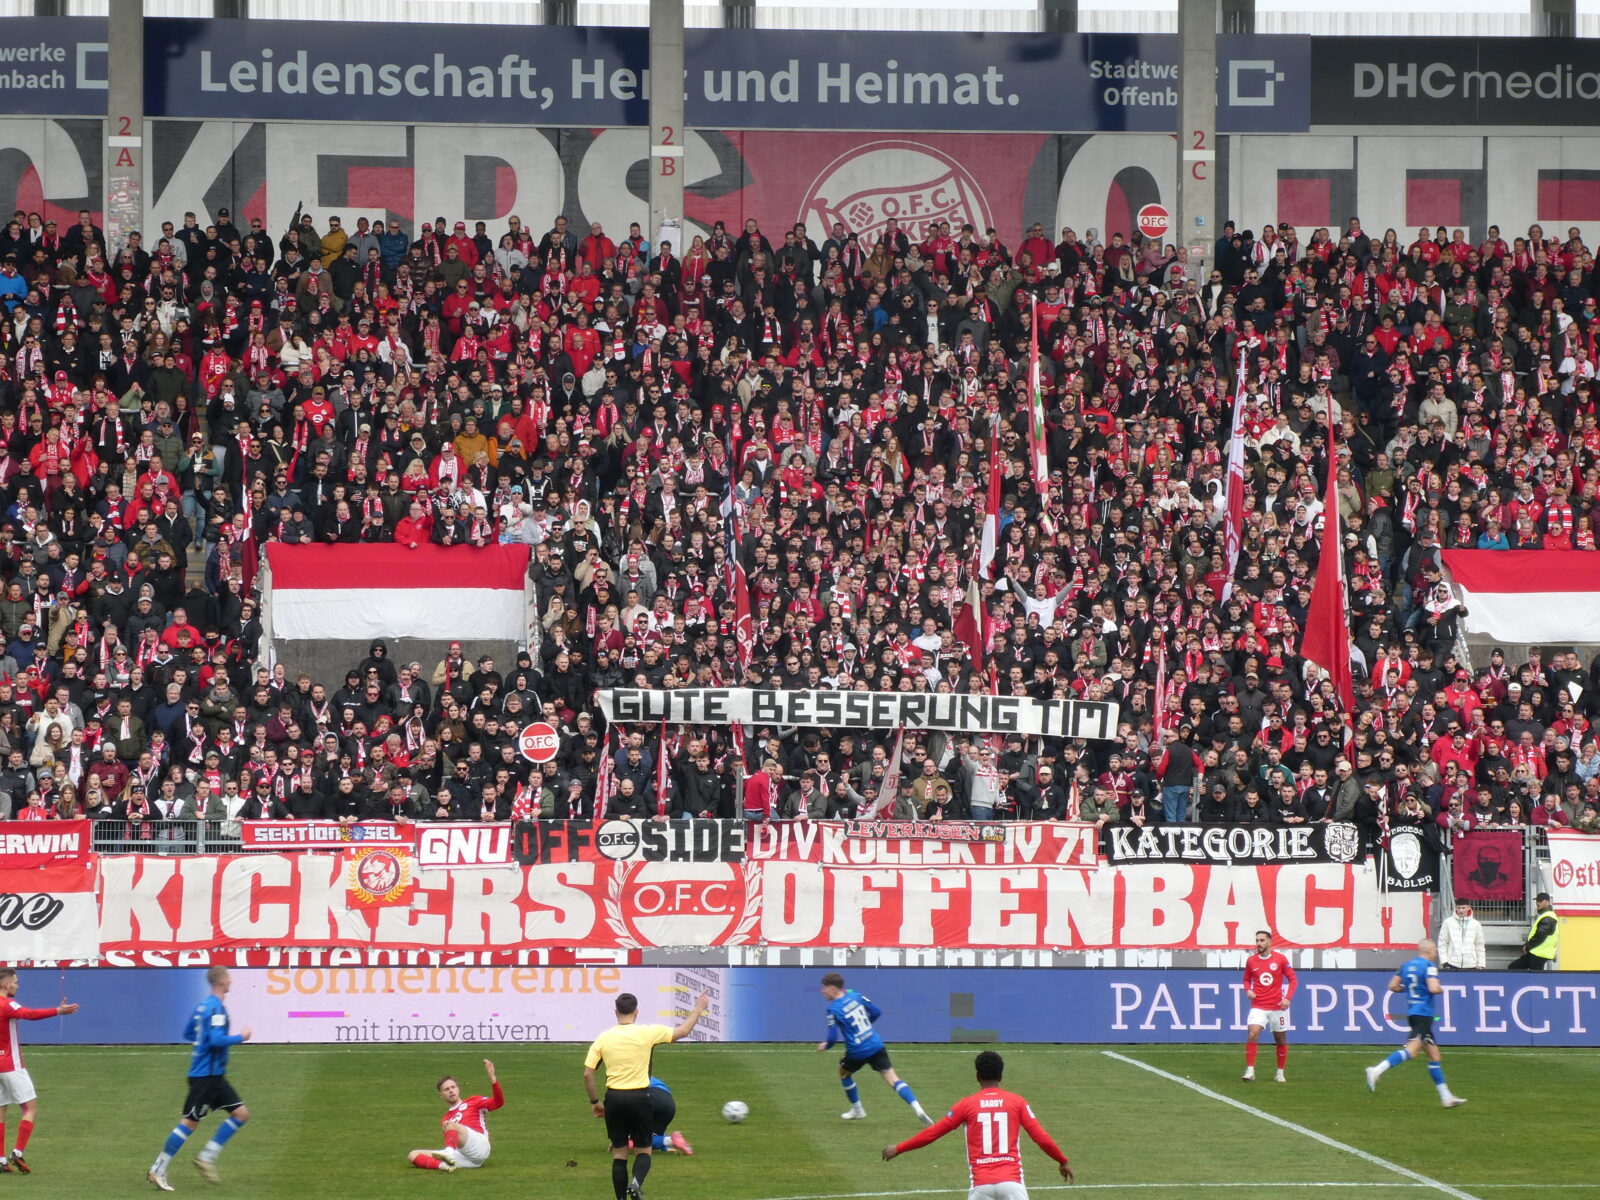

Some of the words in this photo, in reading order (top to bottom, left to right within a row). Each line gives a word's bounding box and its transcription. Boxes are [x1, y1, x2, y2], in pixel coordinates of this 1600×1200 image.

[201, 48, 554, 108] Leidenschaft,
[703, 59, 799, 102] und
[818, 59, 1020, 106] Heimat.
[118, 116, 131, 136] 2
[661, 126, 674, 145] 2
[1192, 130, 1206, 149] 2
[115, 147, 135, 167] A
[660, 157, 676, 176] B
[1191, 161, 1207, 180] C
[881, 188, 956, 218] O.F.C.
[1141, 215, 1168, 227] O.F.C.
[612, 689, 730, 721] GUTE
[752, 691, 1020, 731] BESSERUNG
[1032, 698, 1109, 739] TIM
[524, 735, 556, 749] O.F.C.
[513, 819, 595, 865] OFF
[599, 832, 637, 847] O.F.C.
[641, 819, 745, 862] SIDE
[847, 821, 980, 841] LEVERKUSEN
[419, 828, 510, 864] GNU
[1052, 826, 1096, 865] 71
[1109, 826, 1317, 860] KATEGORIE
[100, 854, 597, 946] KICKERS
[633, 883, 737, 913] O.F.C.
[265, 967, 622, 995] sonnencreme
[335, 1019, 380, 1041] mit
[388, 1019, 550, 1041] innovativem
[980, 1099, 1004, 1108] BARRY
[976, 1112, 1008, 1155] 11
